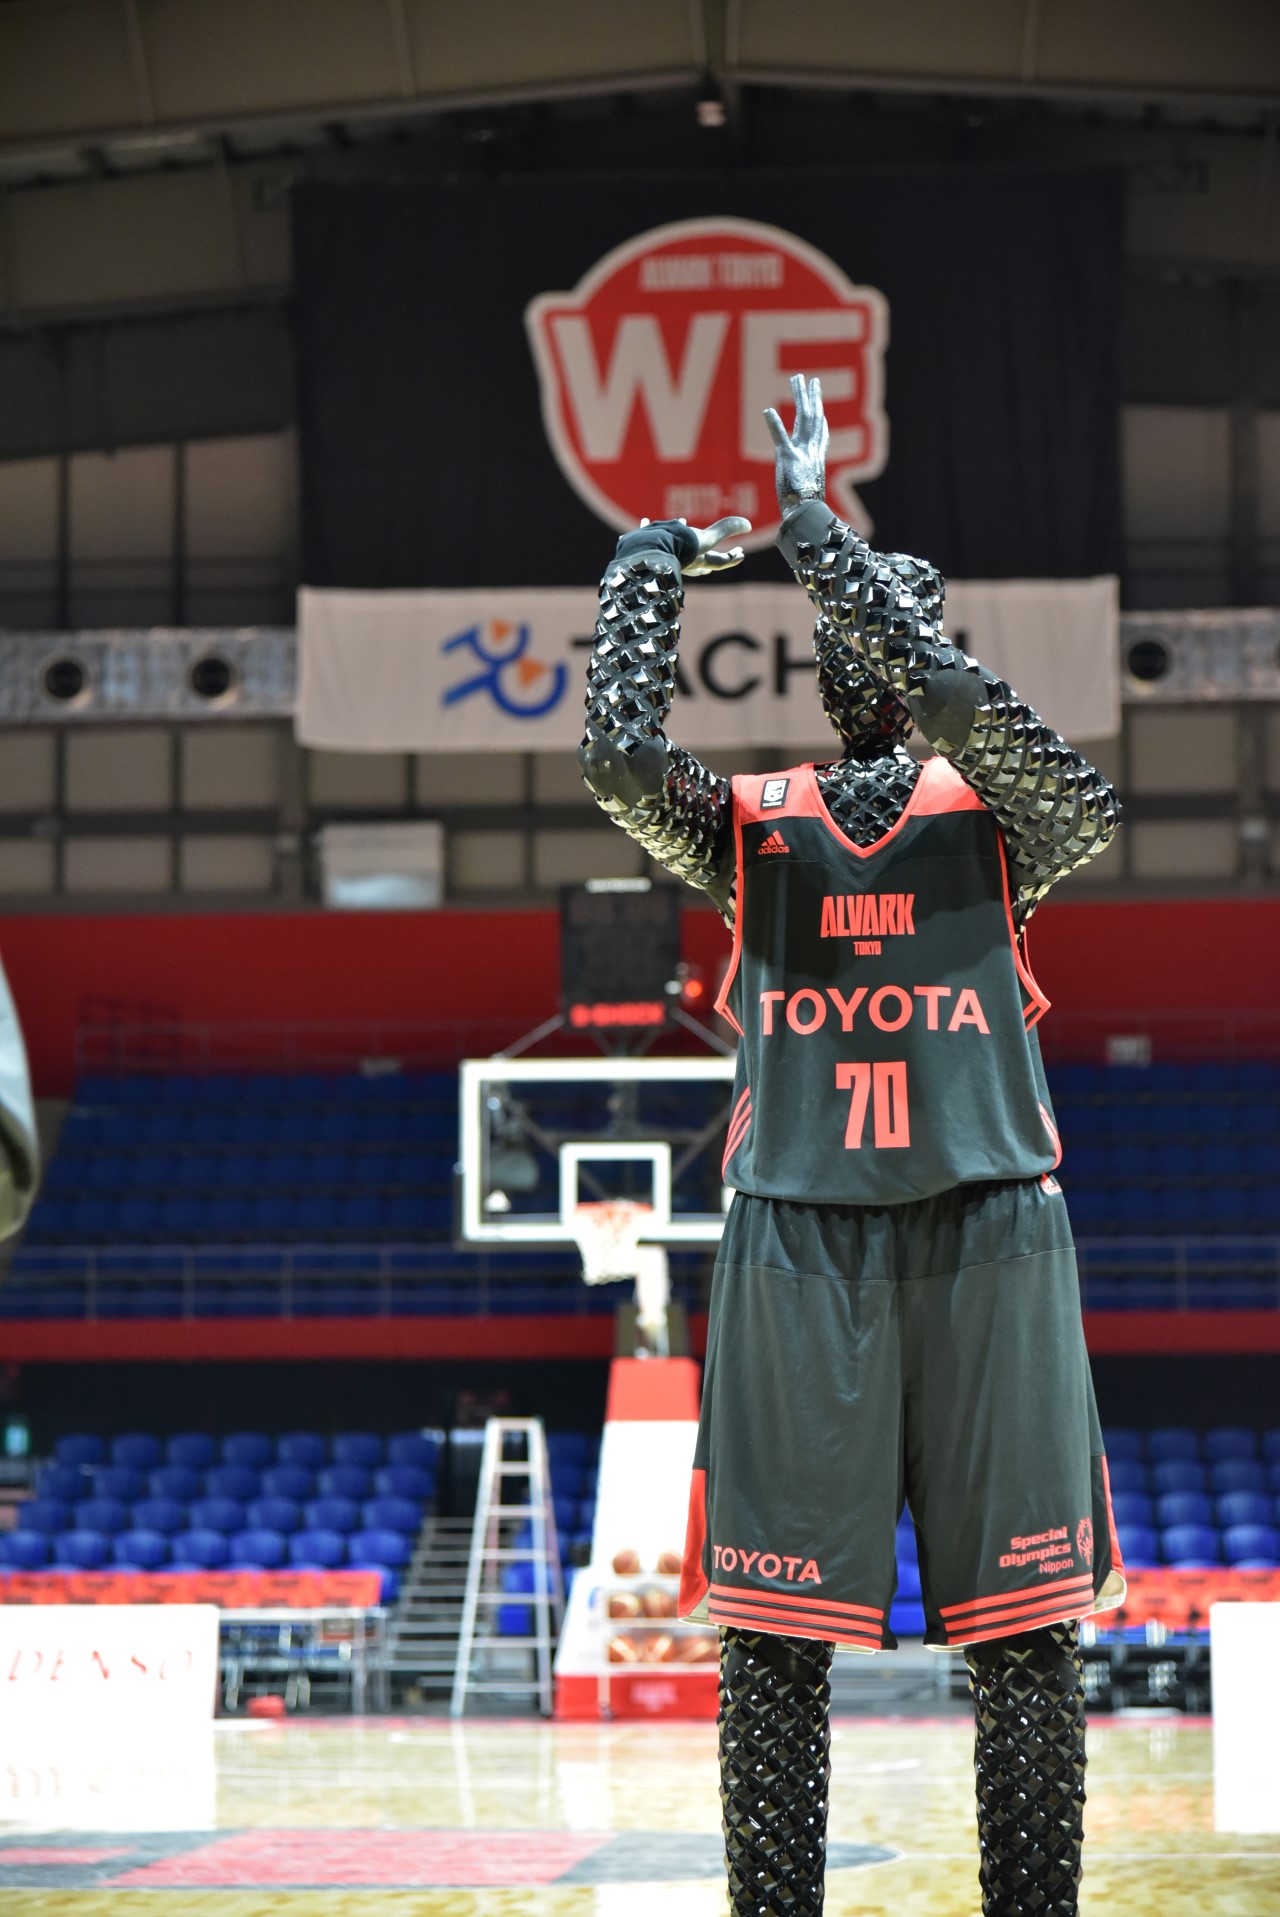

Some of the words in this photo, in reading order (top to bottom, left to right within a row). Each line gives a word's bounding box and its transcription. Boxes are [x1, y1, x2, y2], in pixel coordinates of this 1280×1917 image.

[551, 309, 864, 464] WE
[757, 845, 790, 855] adidas
[820, 893, 916, 938] ALVARK
[853, 941, 882, 956] TOKYO
[760, 985, 991, 1036] TOYOTA
[835, 1061, 911, 1150] 70
[1010, 1526, 1069, 1550] Special
[713, 1545, 822, 1585] TOYOTA
[999, 1542, 1072, 1568] Olympics
[1039, 1558, 1075, 1575] Nippon
